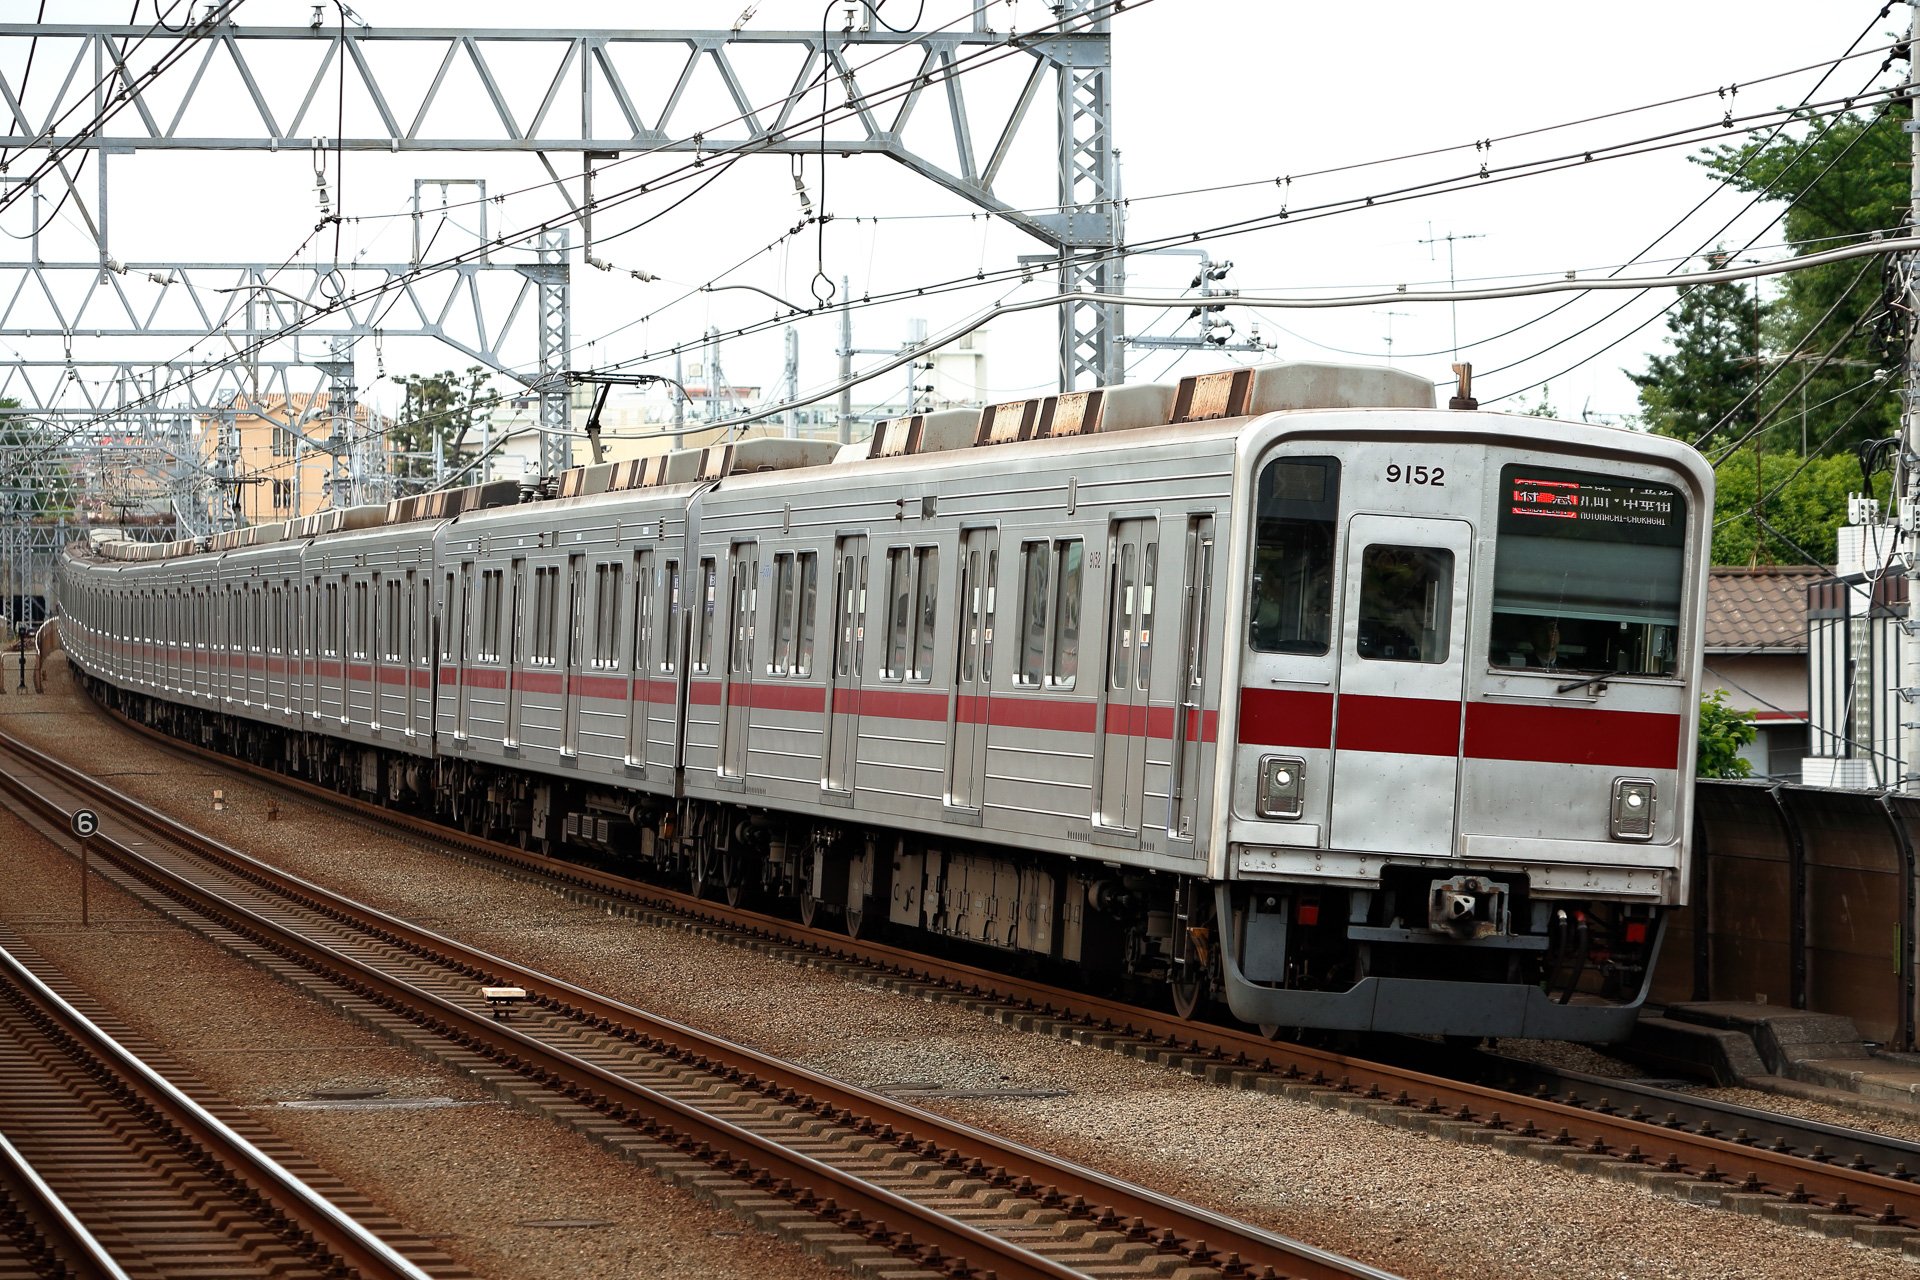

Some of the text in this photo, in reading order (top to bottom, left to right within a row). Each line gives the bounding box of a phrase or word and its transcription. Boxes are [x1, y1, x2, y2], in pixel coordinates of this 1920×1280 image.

[1386, 464, 1445, 487] 9152
[1089, 551, 1102, 569] 9152
[77, 812, 93, 833] 6
